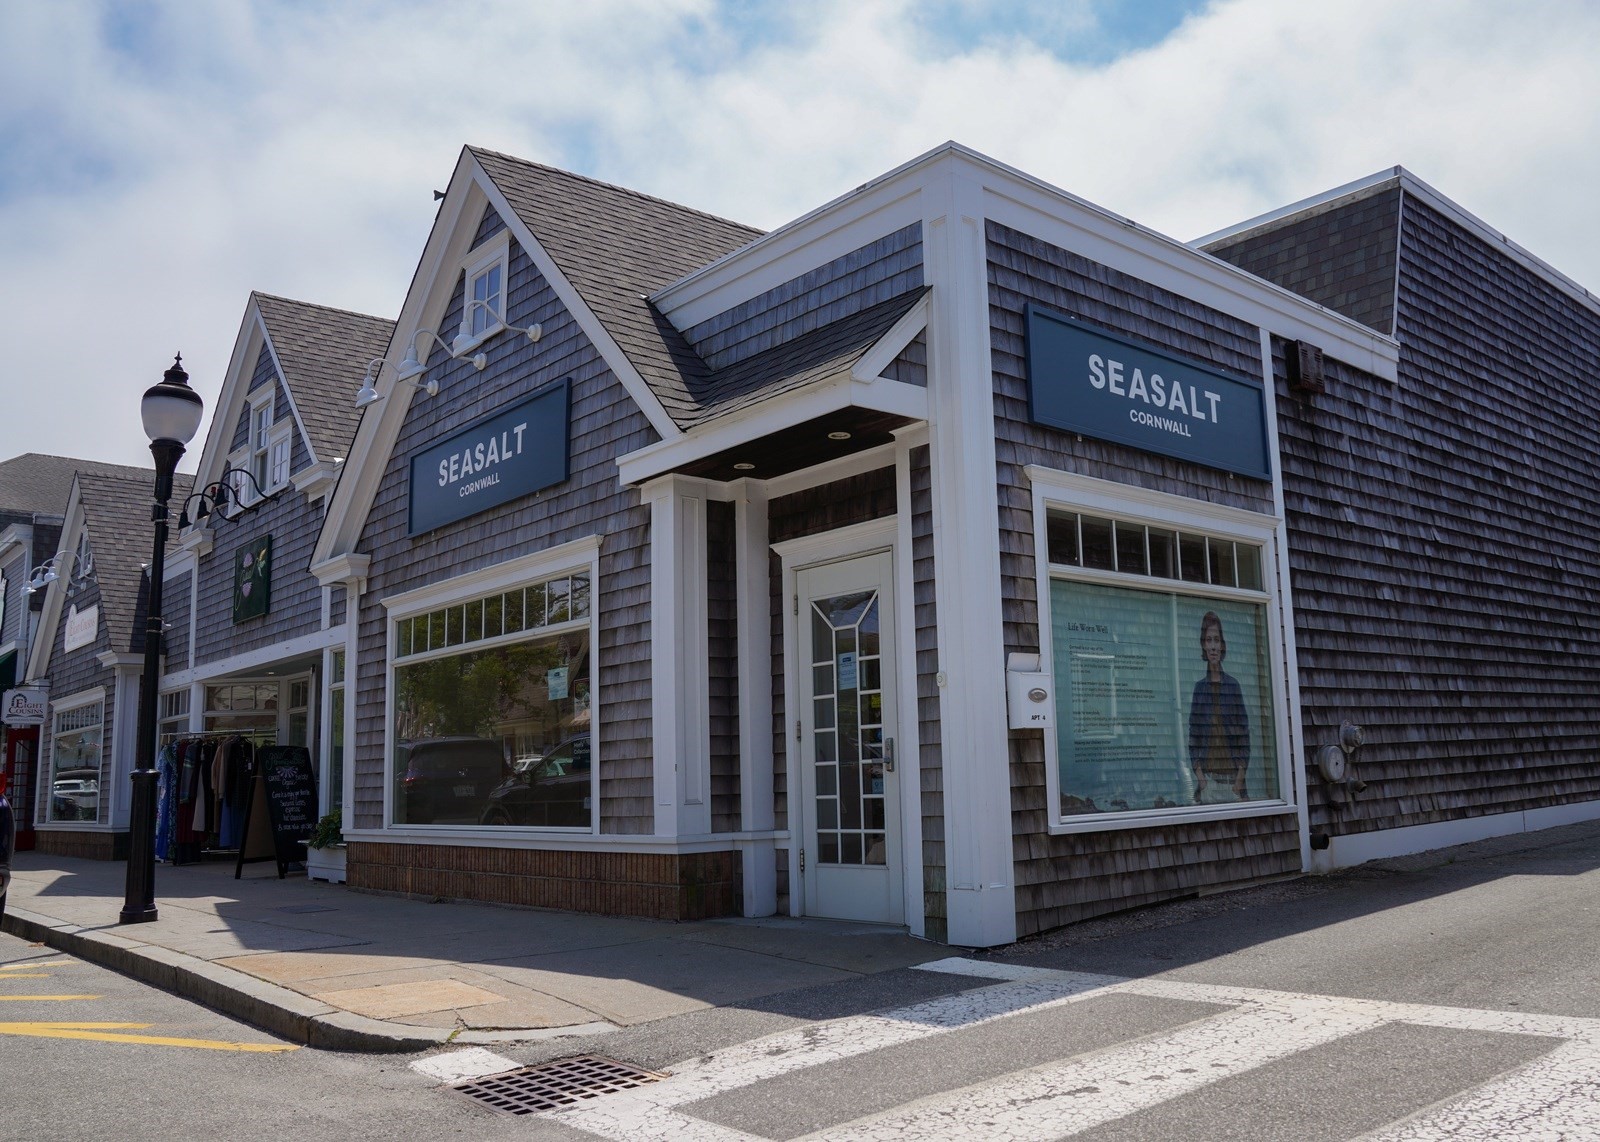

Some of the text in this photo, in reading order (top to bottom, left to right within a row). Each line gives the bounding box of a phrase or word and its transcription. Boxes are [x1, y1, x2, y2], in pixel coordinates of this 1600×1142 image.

[1088, 353, 1221, 424] SEASALT
[1129, 409, 1192, 438] CORNWALL
[438, 422, 527, 487] SEASALT
[459, 472, 500, 498] CORNWALL
[8, 706, 44, 714] COUSINS
[15, 699, 44, 709] EIGHT
